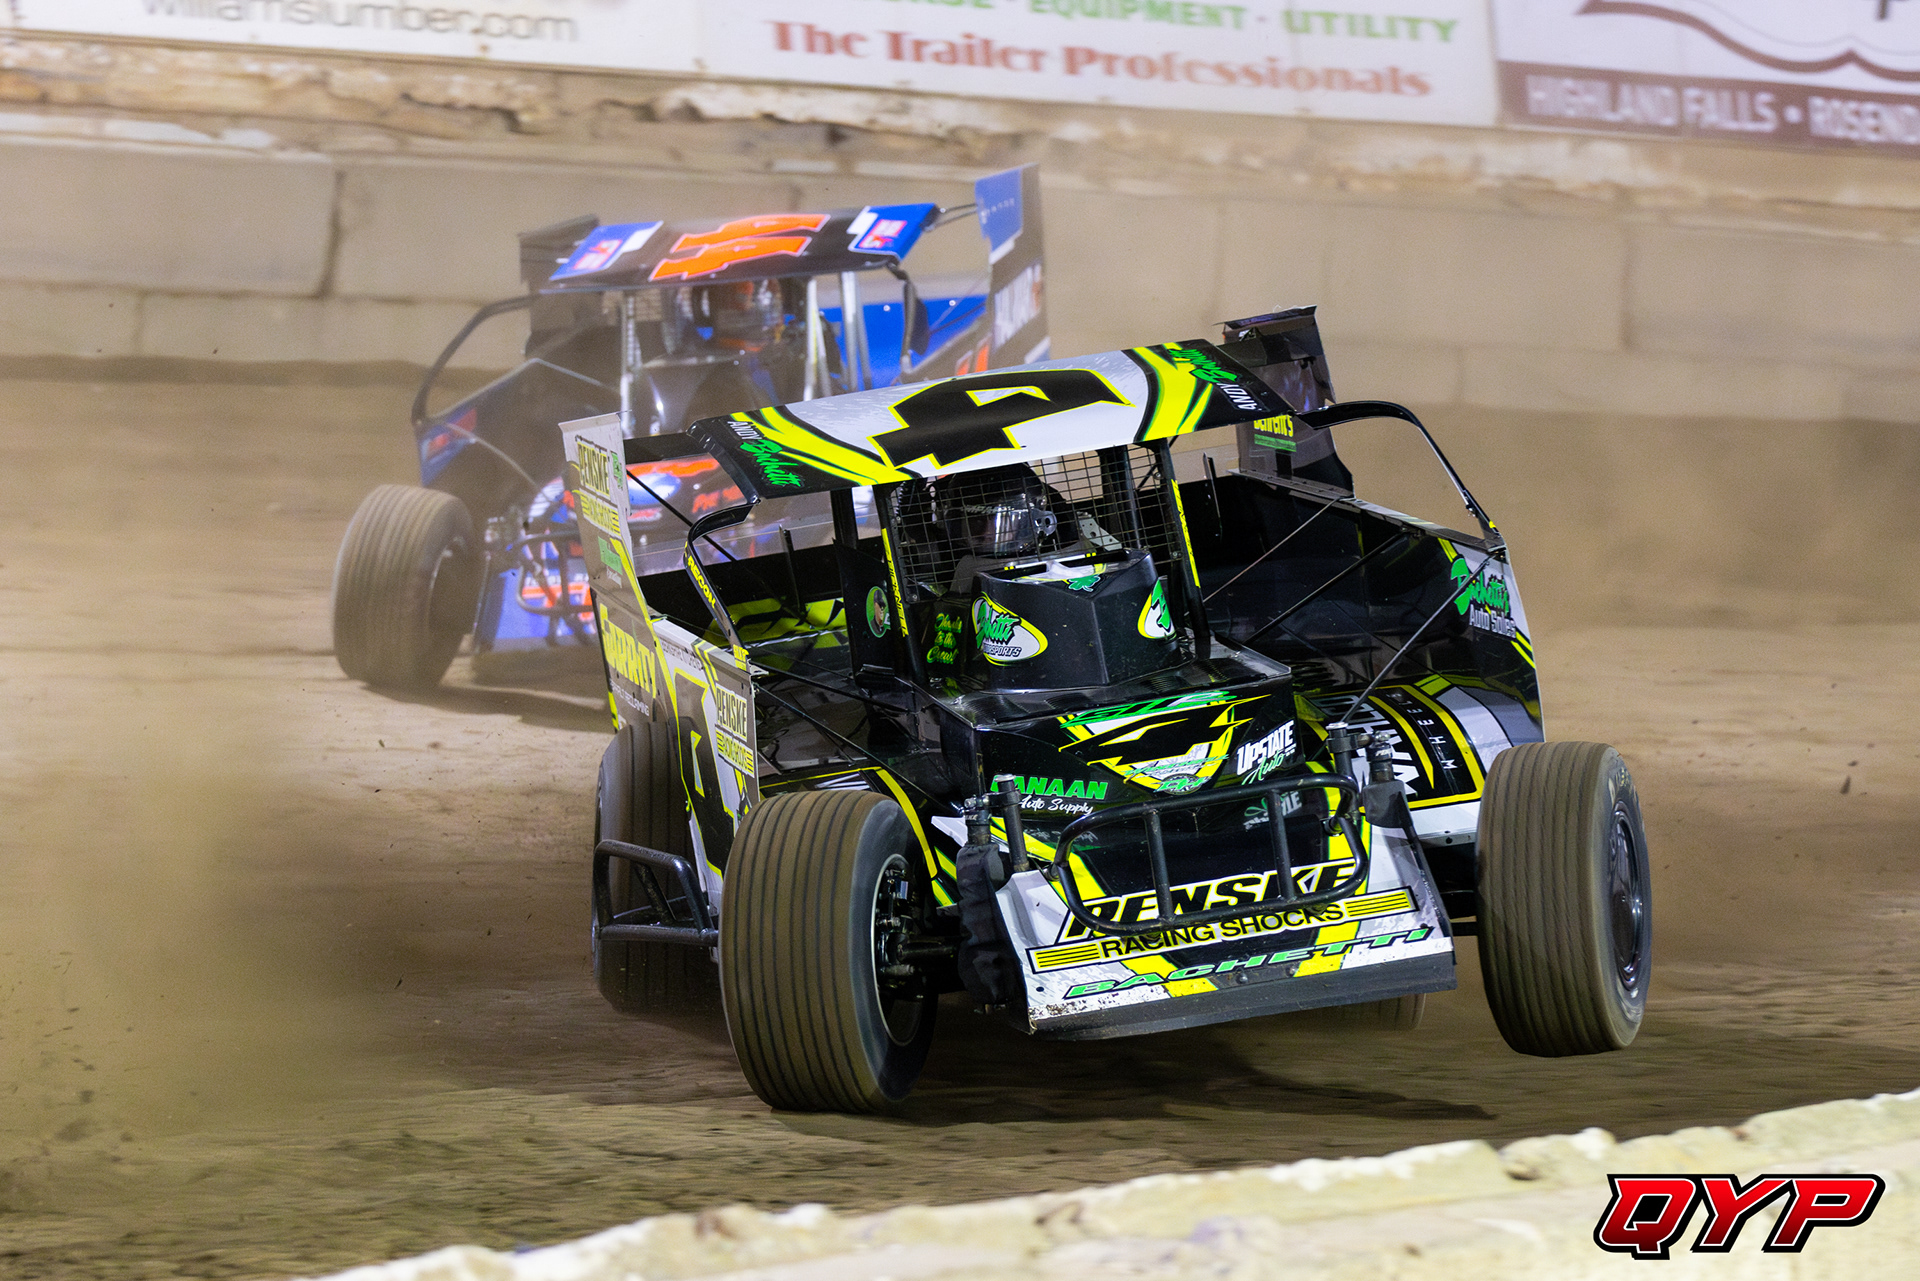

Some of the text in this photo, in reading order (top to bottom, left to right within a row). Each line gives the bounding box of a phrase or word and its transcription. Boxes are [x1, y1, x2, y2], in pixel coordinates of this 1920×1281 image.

[1281, 9, 1457, 42] UTILITY
[763, 20, 1432, 97] The Trailer Professionals
[1683, 86, 1778, 133] FALLS
[727, 421, 763, 440] ANDY
[715, 685, 748, 738] PENSKE
[1236, 719, 1296, 776] UPSTATE
[1241, 750, 1286, 786] Auto
[1047, 797, 1094, 818] Supply
[1063, 858, 1358, 940] PENSKE
[1100, 901, 1346, 960] RACING SHOCKS
[1063, 925, 1434, 1001] BACHETTI
